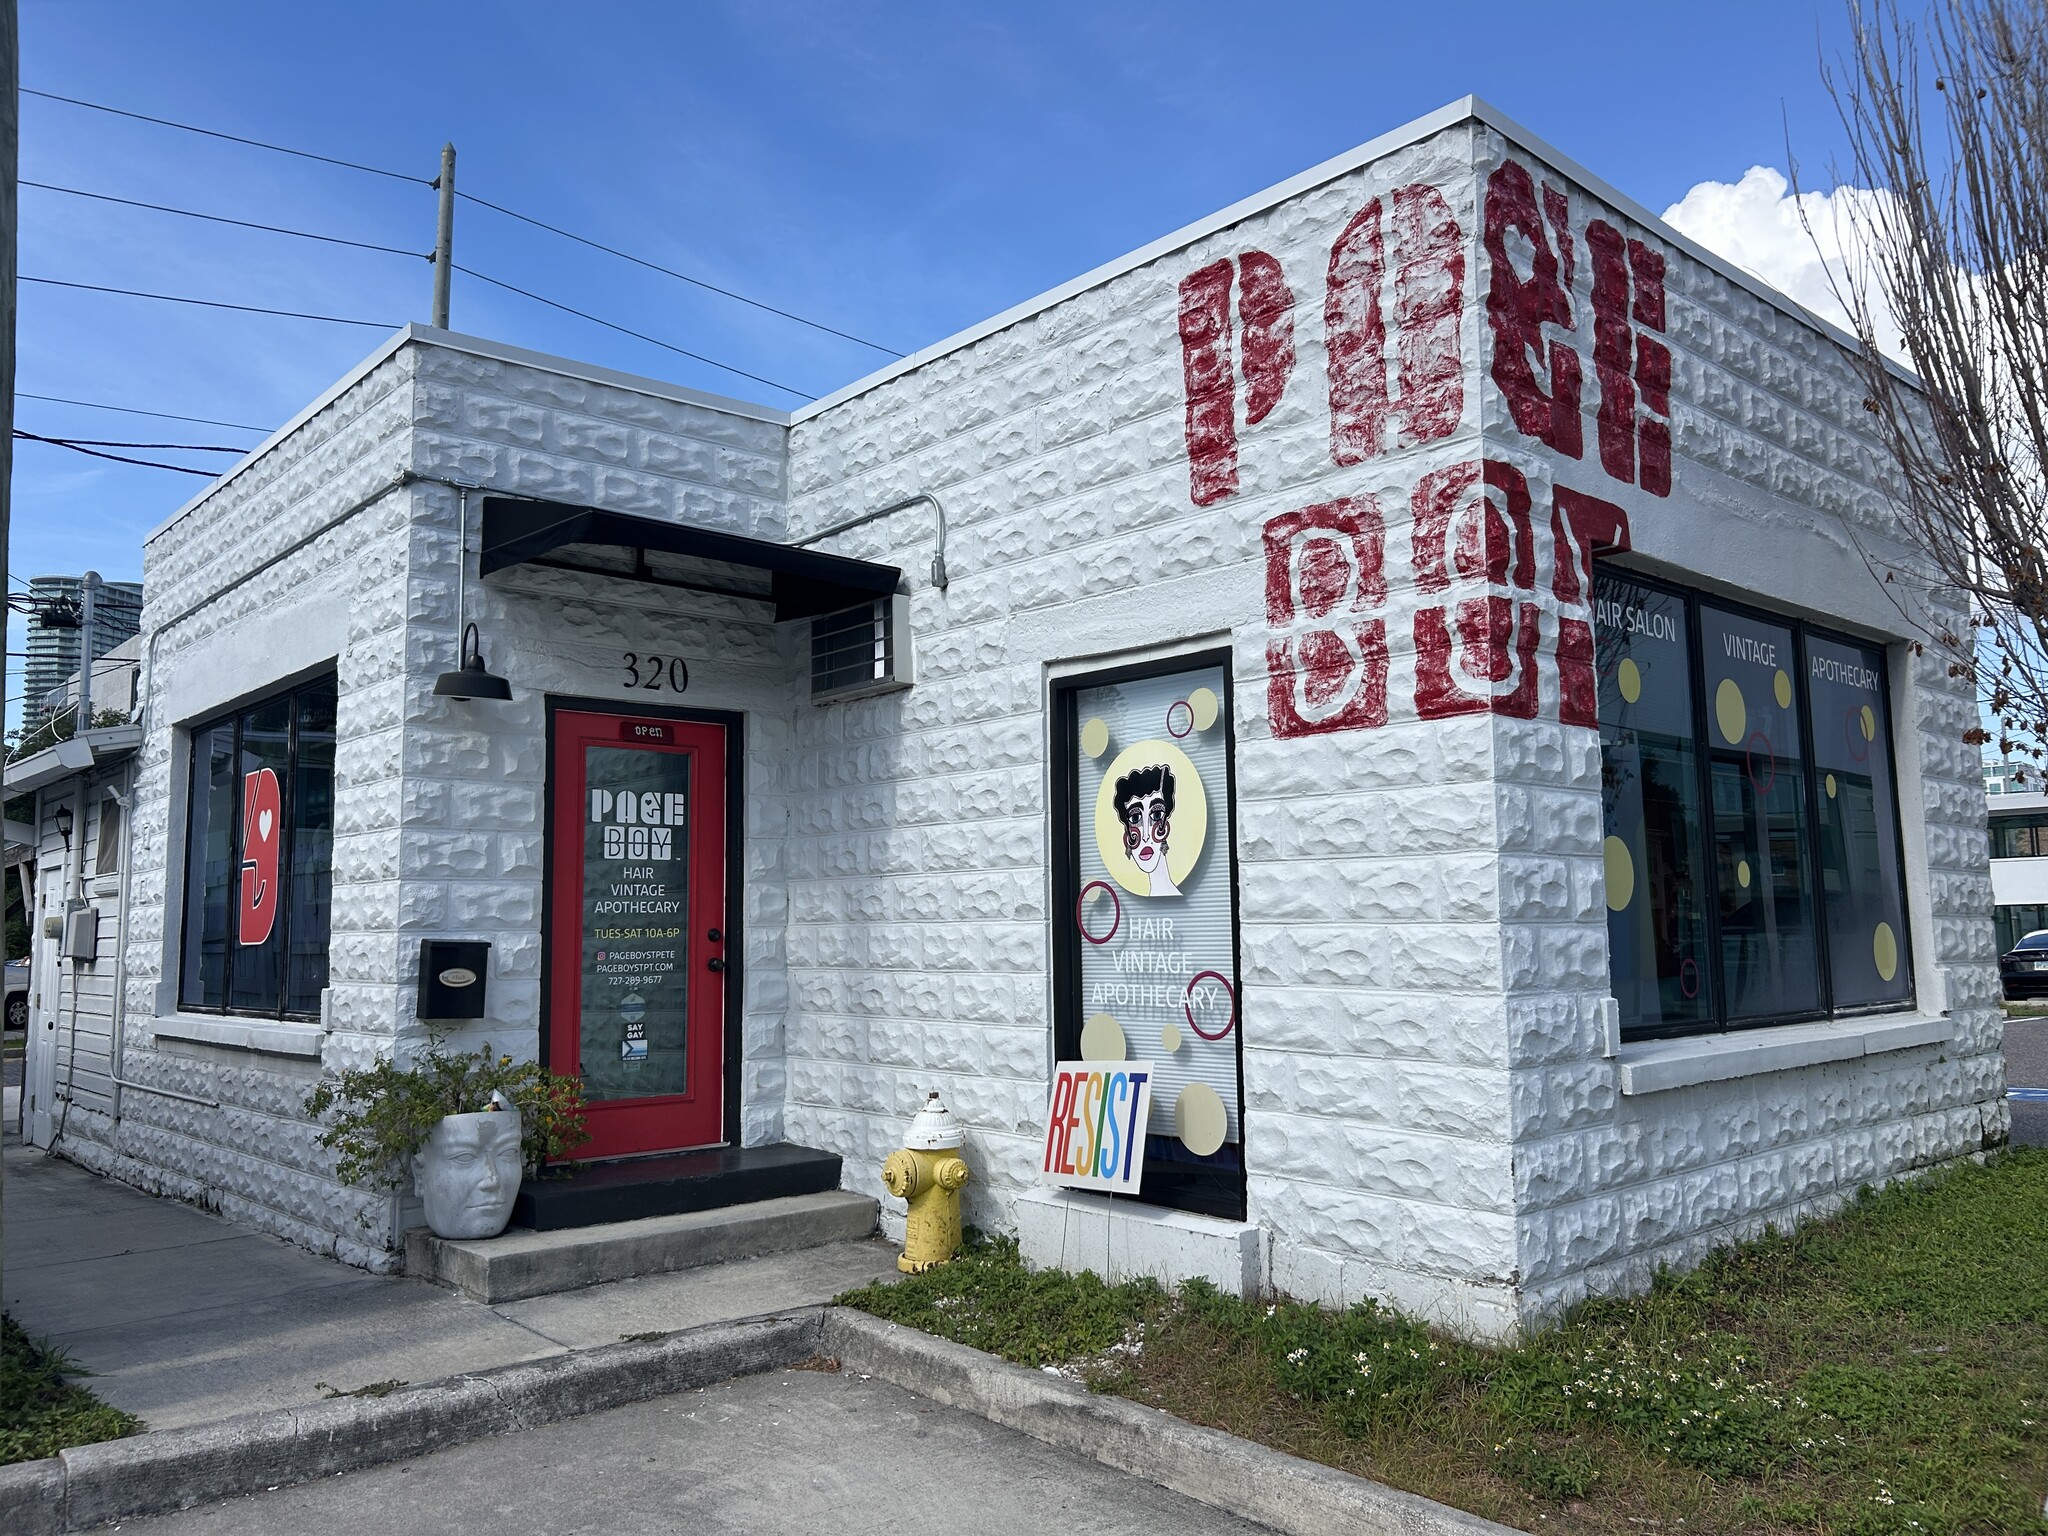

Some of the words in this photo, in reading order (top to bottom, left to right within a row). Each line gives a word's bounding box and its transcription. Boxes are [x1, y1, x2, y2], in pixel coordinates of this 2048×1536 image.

[1178, 158, 1672, 506] PAGE
[1262, 458, 1632, 739] BOY
[1596, 599, 1622, 630] AIR
[1627, 606, 1676, 642] SALON
[1722, 632, 1777, 668] VINTAGE
[623, 652, 689, 693] 320
[1811, 656, 1879, 692] APOTHECARY
[591, 789, 684, 826] PAGE
[603, 825, 672, 861] BOY
[623, 866, 654, 879] HAIR
[610, 884, 666, 896] VINTAGE
[594, 901, 680, 914] APOTHECARY
[594, 928, 643, 939] TUES-SAT
[644, 927, 680, 938] 10A-6P
[1129, 917, 1175, 940] HAIR
[596, 962, 674, 973] PAGEBOYSTPT.COM
[609, 950, 676, 961] PAGEBOYSTPETE
[1112, 950, 1194, 975] VINTAGE
[608, 975, 663, 986] 727-289-9677
[1091, 982, 1219, 1010] APOTHECARY
[626, 1031, 644, 1040] GAY
[627, 1023, 644, 1032] SAY
[1043, 1071, 1149, 1183] RESIST
